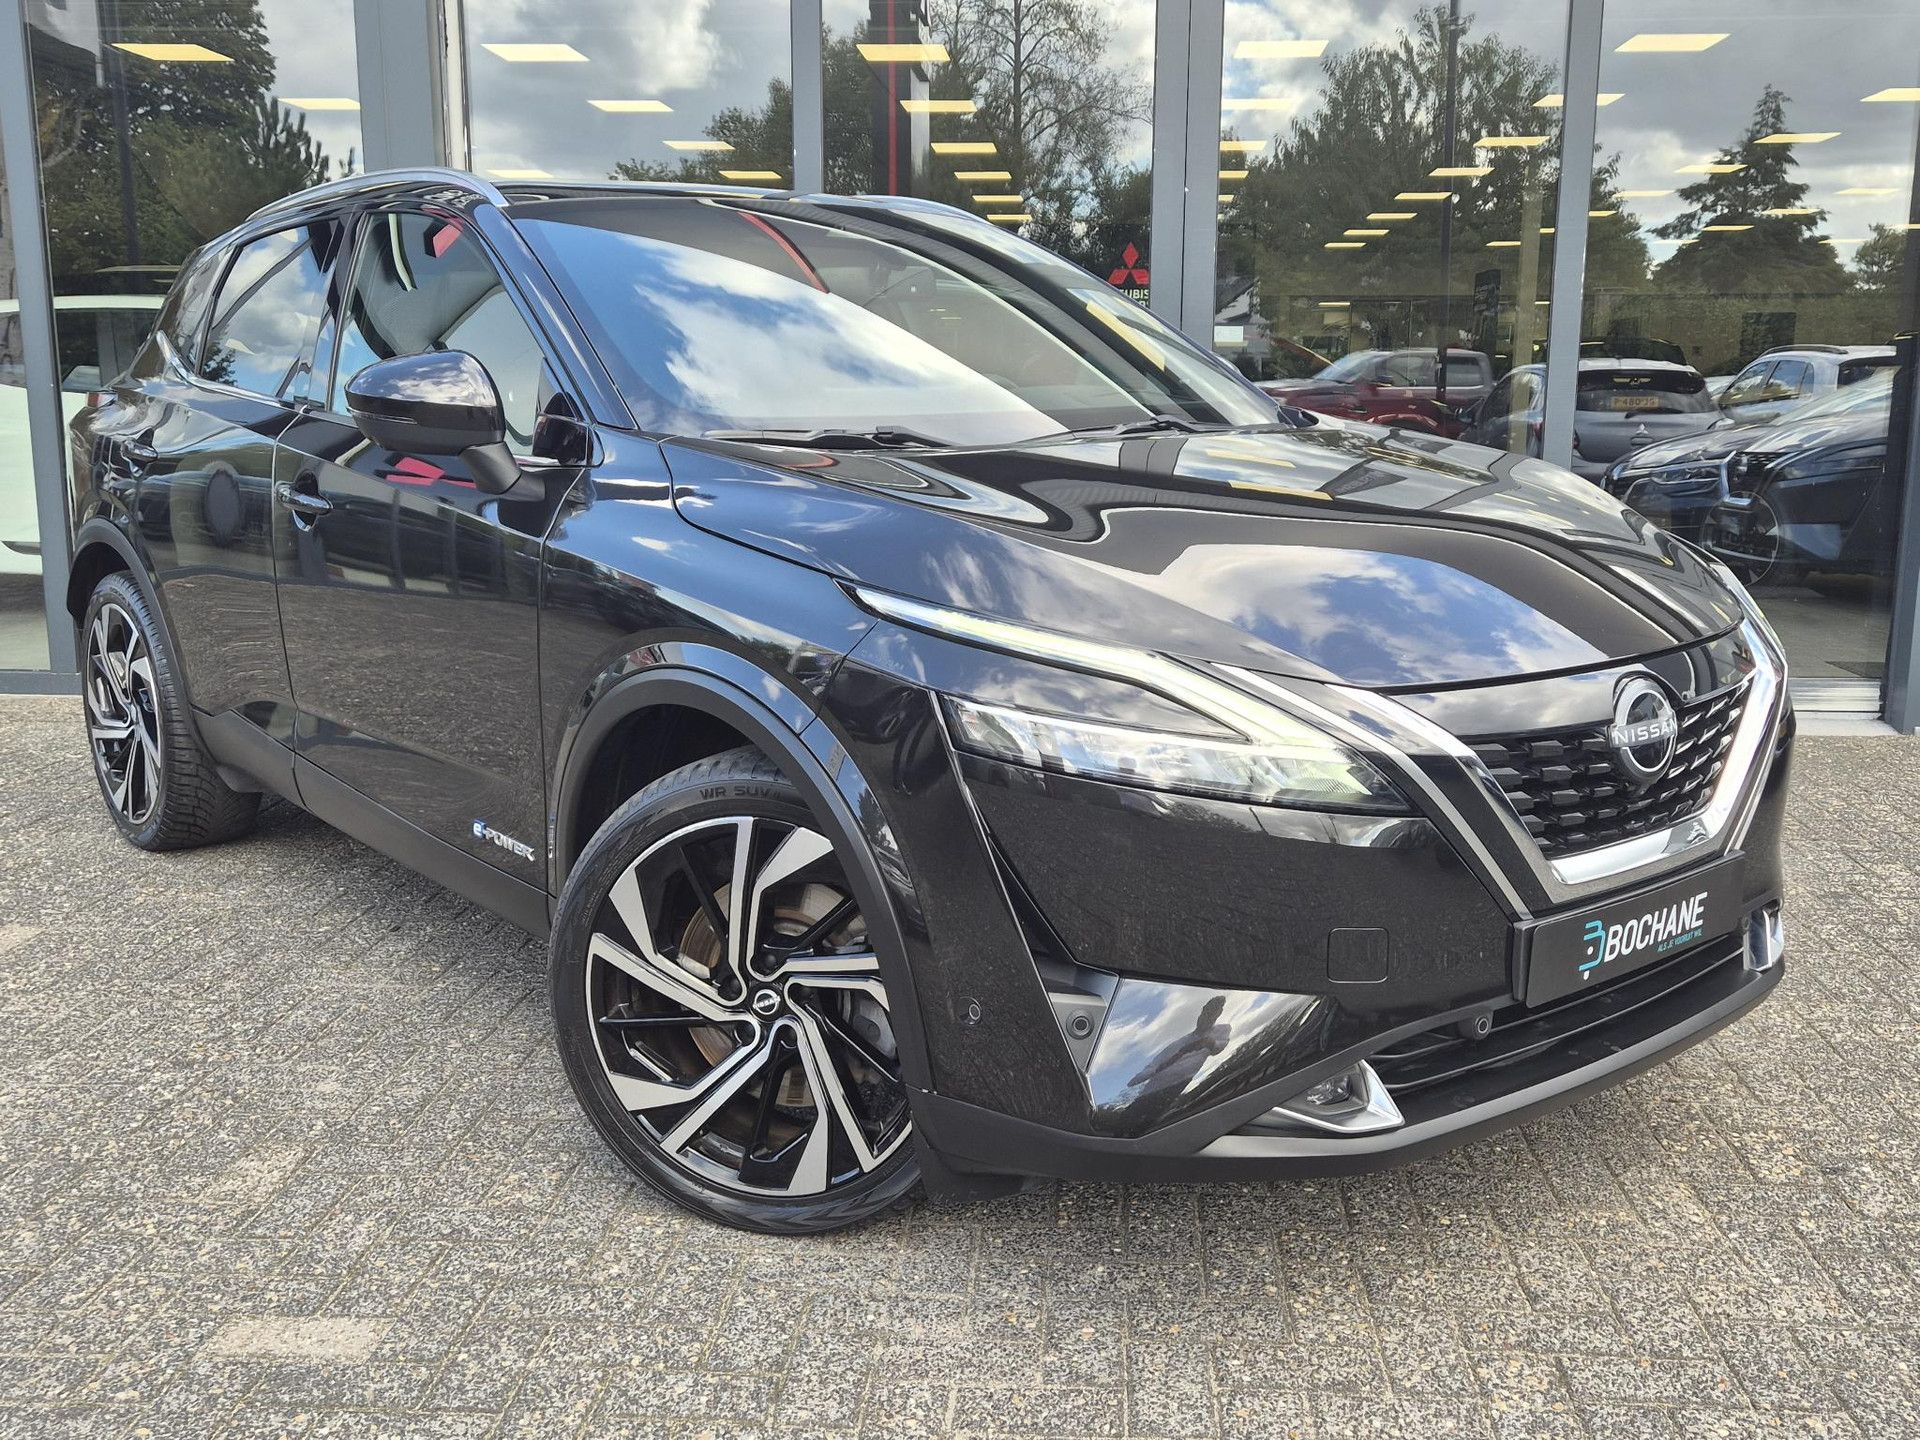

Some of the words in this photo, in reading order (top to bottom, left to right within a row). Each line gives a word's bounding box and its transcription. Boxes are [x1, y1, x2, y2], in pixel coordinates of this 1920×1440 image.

[1120, 289, 1150, 299] UBIS
[1612, 718, 1676, 746] NISSAN
[699, 786, 727, 800] WR
[1603, 891, 1708, 963] BOCHANE
